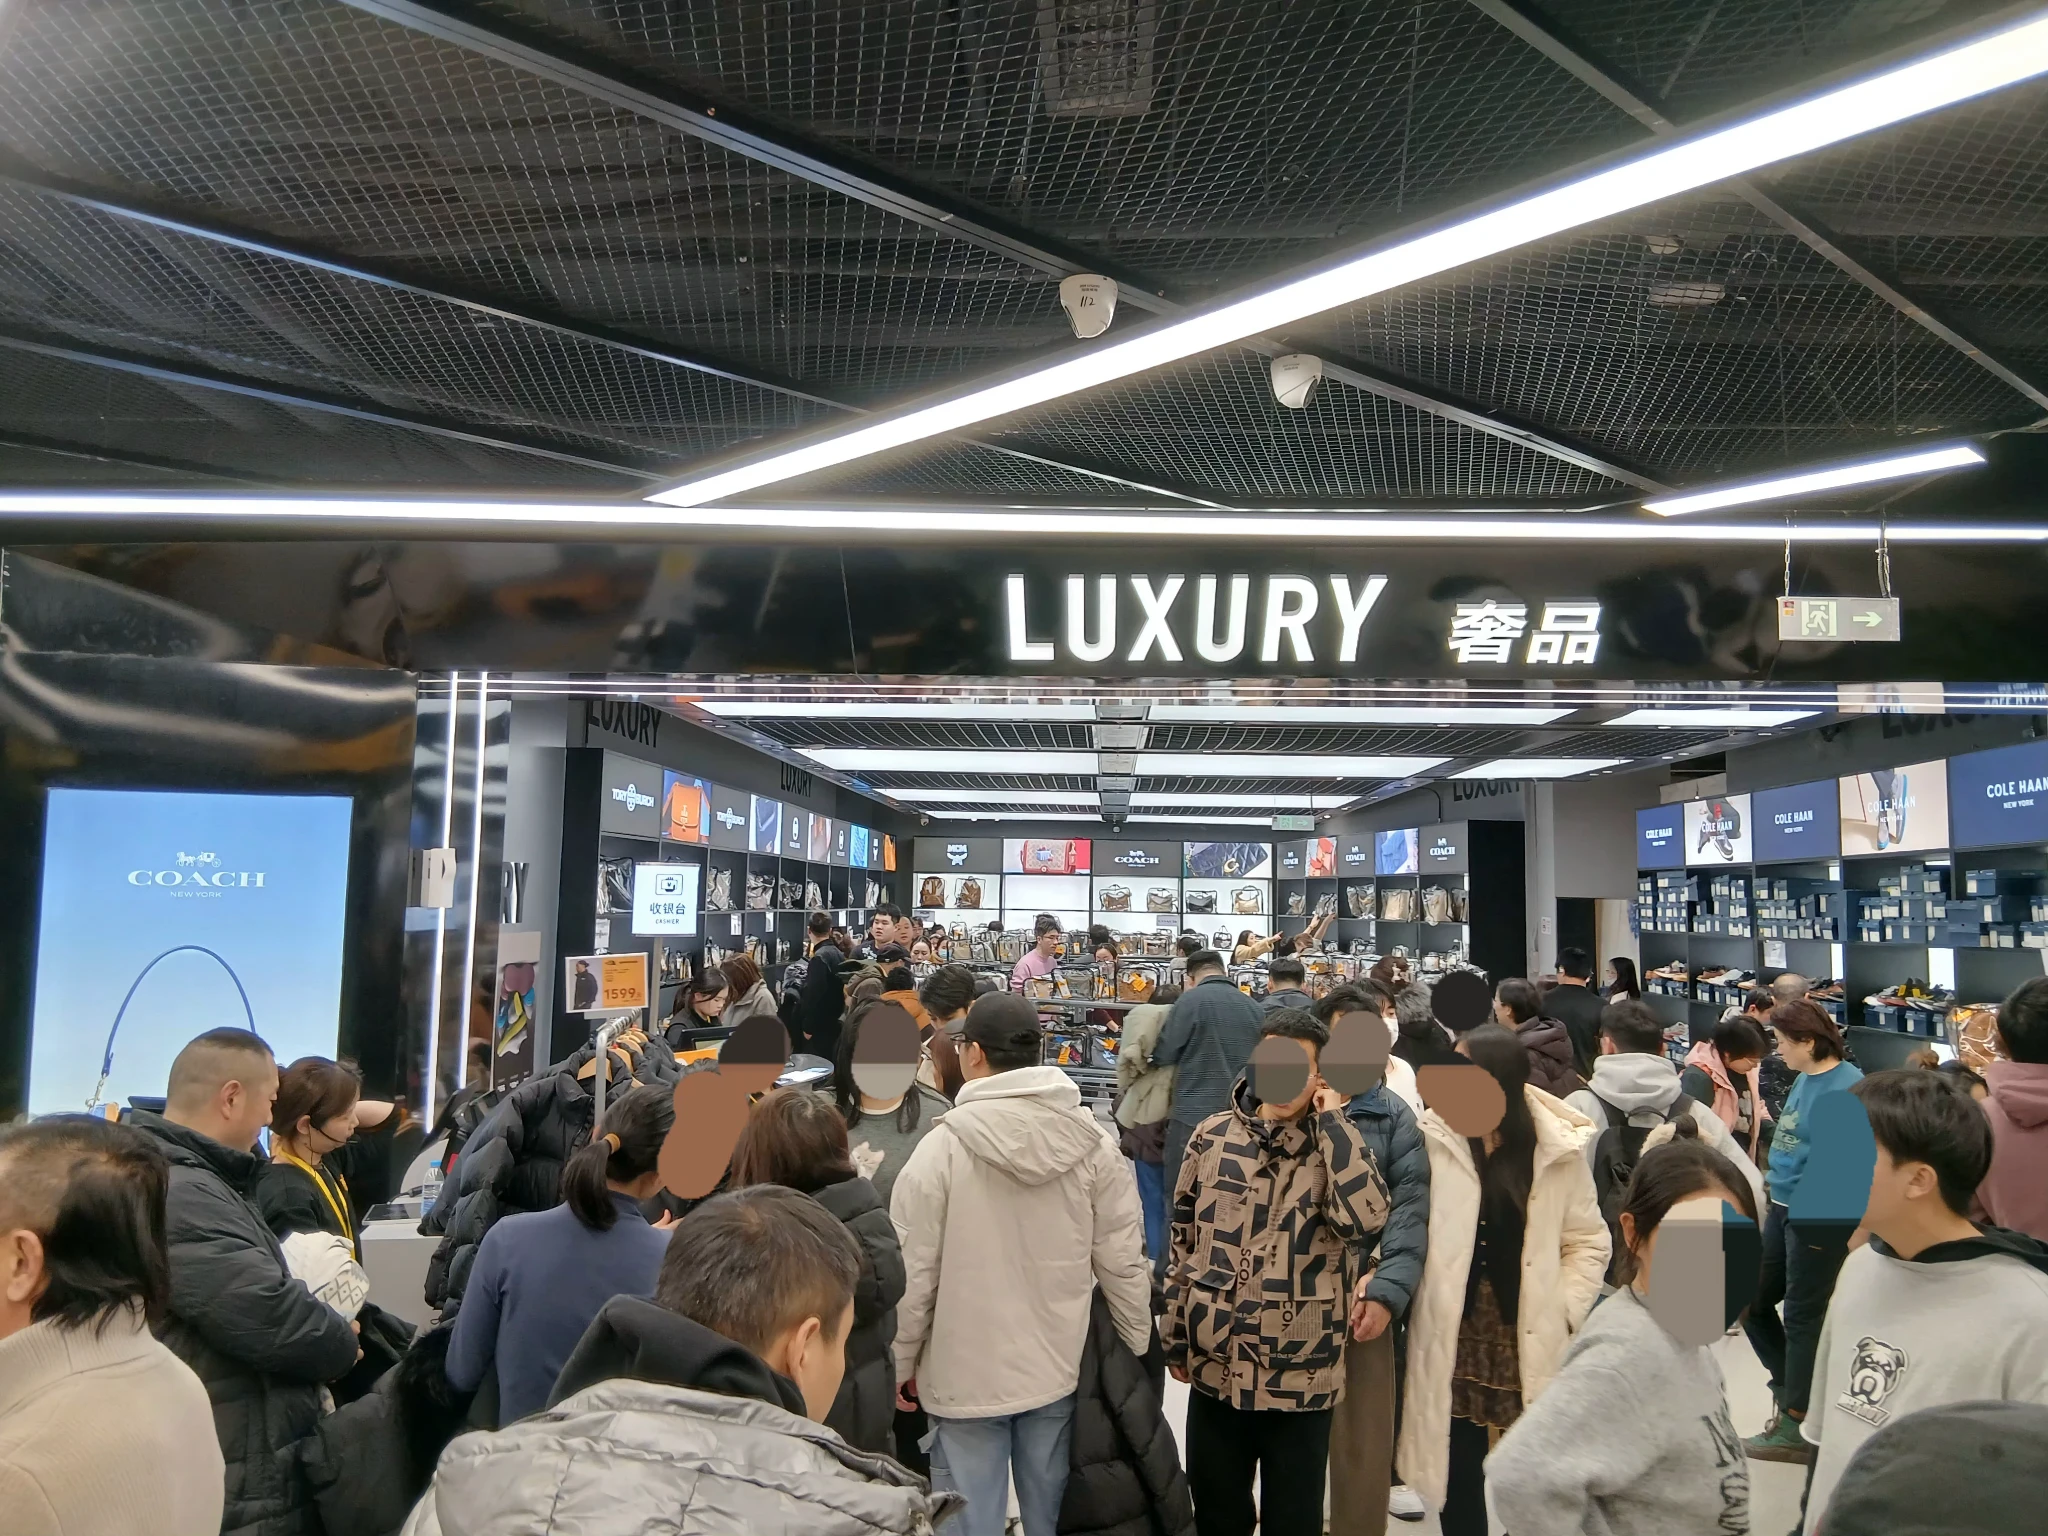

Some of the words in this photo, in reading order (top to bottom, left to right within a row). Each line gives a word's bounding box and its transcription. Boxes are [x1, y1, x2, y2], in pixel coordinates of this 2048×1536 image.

[1080, 296, 1096, 307] 112
[1006, 573, 1388, 662] LUXURY
[1448, 598, 1604, 666] 奢品
[587, 700, 662, 748] LUXURY
[781, 761, 813, 798] LUXURY
[1986, 782, 2016, 798] COLE
[2019, 777, 2048, 794] HAAN
[1867, 800, 1889, 813] COLE
[1892, 796, 1916, 810] HAAN
[1774, 812, 1793, 824] COLE
[1794, 810, 1813, 822] HAAN
[1701, 822, 1716, 832] COLE
[1717, 820, 1733, 831] HAAN
[1429, 846, 1456, 856] COACH
[1114, 856, 1160, 864] COACH
[127, 869, 267, 888] COACH
[650, 902, 686, 915] 收银台
[604, 988, 636, 1000] 1599
